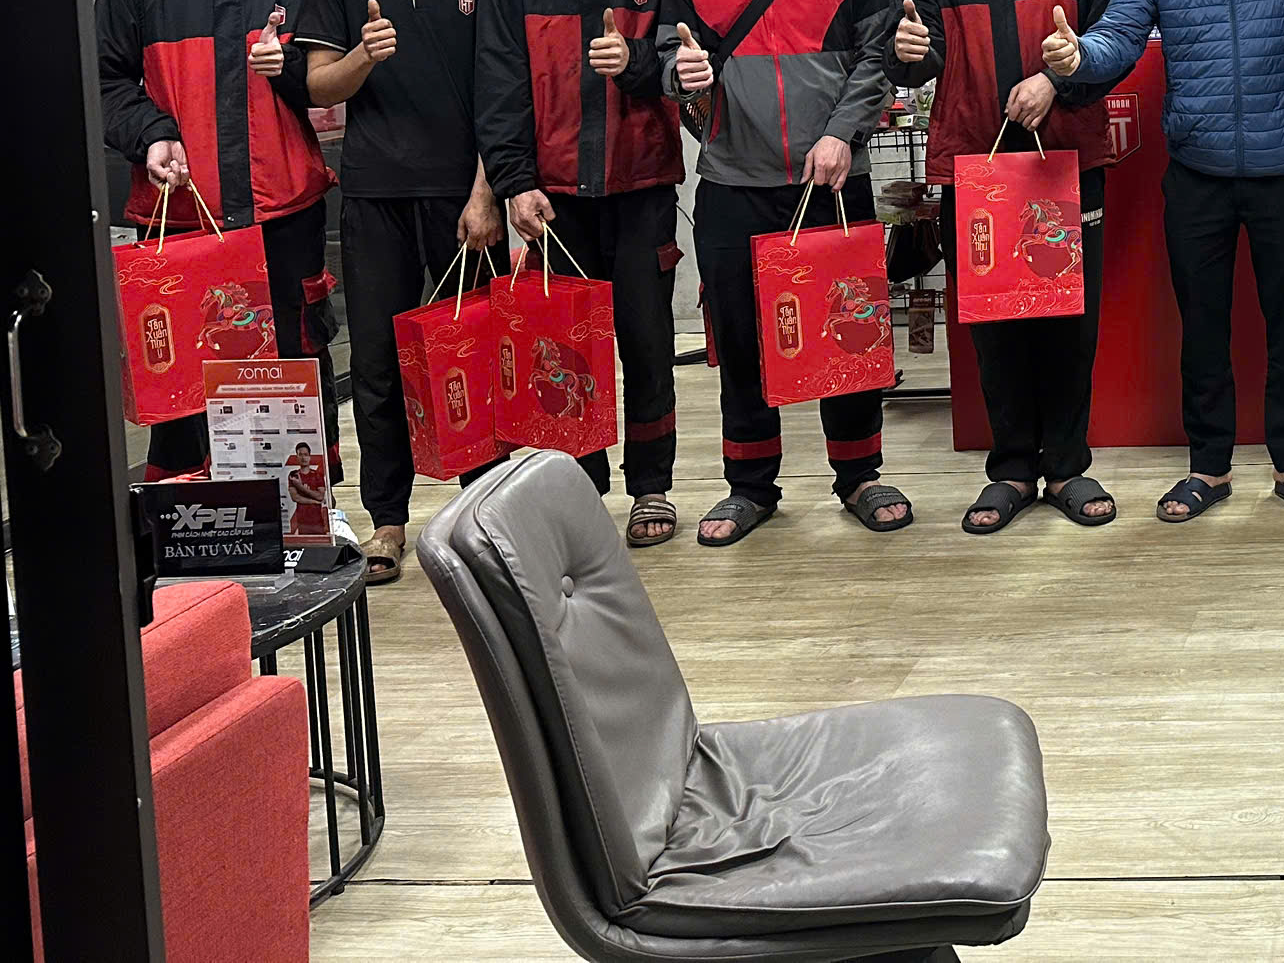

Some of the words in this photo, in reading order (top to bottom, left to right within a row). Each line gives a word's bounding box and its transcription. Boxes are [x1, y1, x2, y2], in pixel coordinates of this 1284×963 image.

[1107, 99, 1131, 109] THANH
[237, 364, 283, 380] 7omai
[171, 503, 254, 531] XPEL
[164, 542, 195, 558] BÀN
[198, 543, 220, 556] TƯ
[221, 538, 254, 556] VẤN
